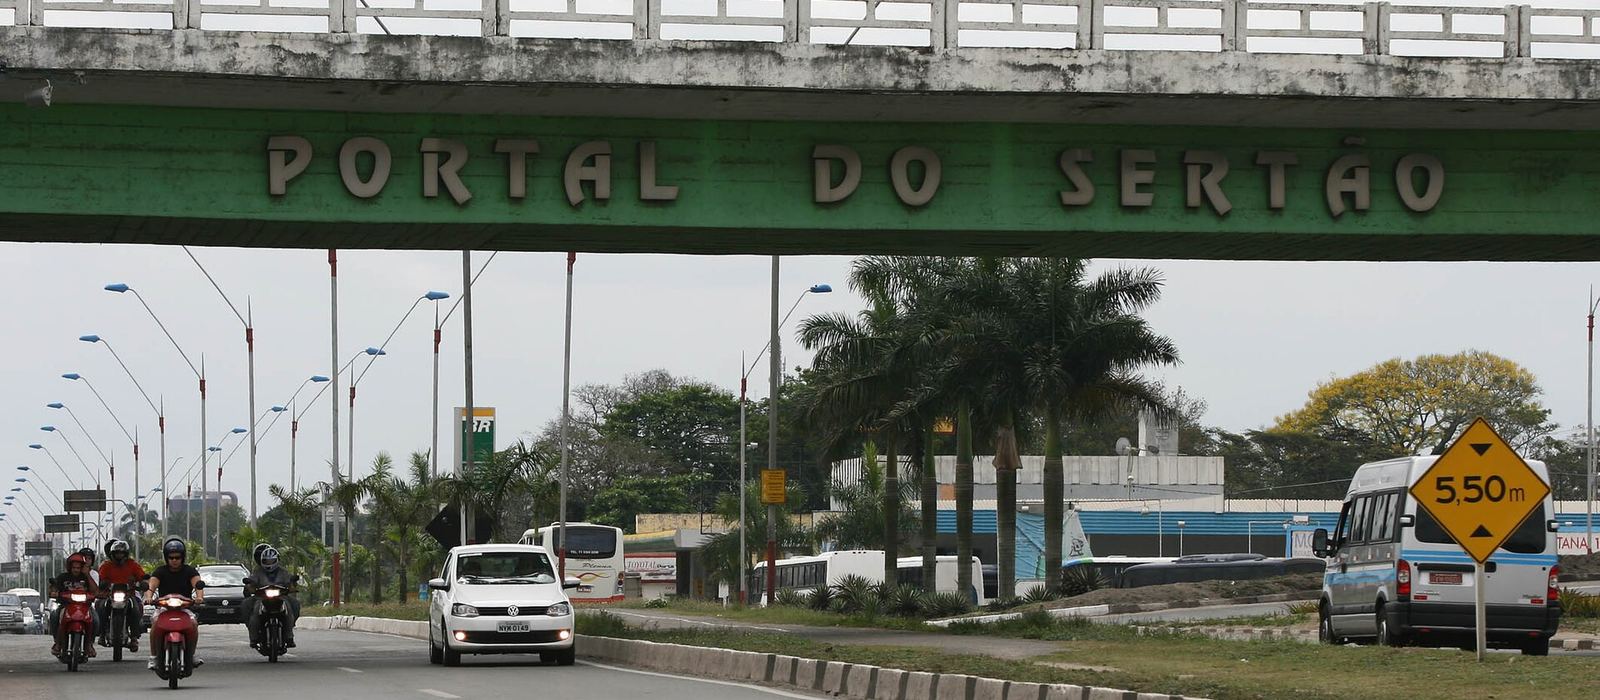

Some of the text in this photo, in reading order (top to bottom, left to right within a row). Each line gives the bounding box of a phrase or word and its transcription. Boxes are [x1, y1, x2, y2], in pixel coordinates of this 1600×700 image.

[267, 135, 1445, 217] PORTAL DO SERTÃO
